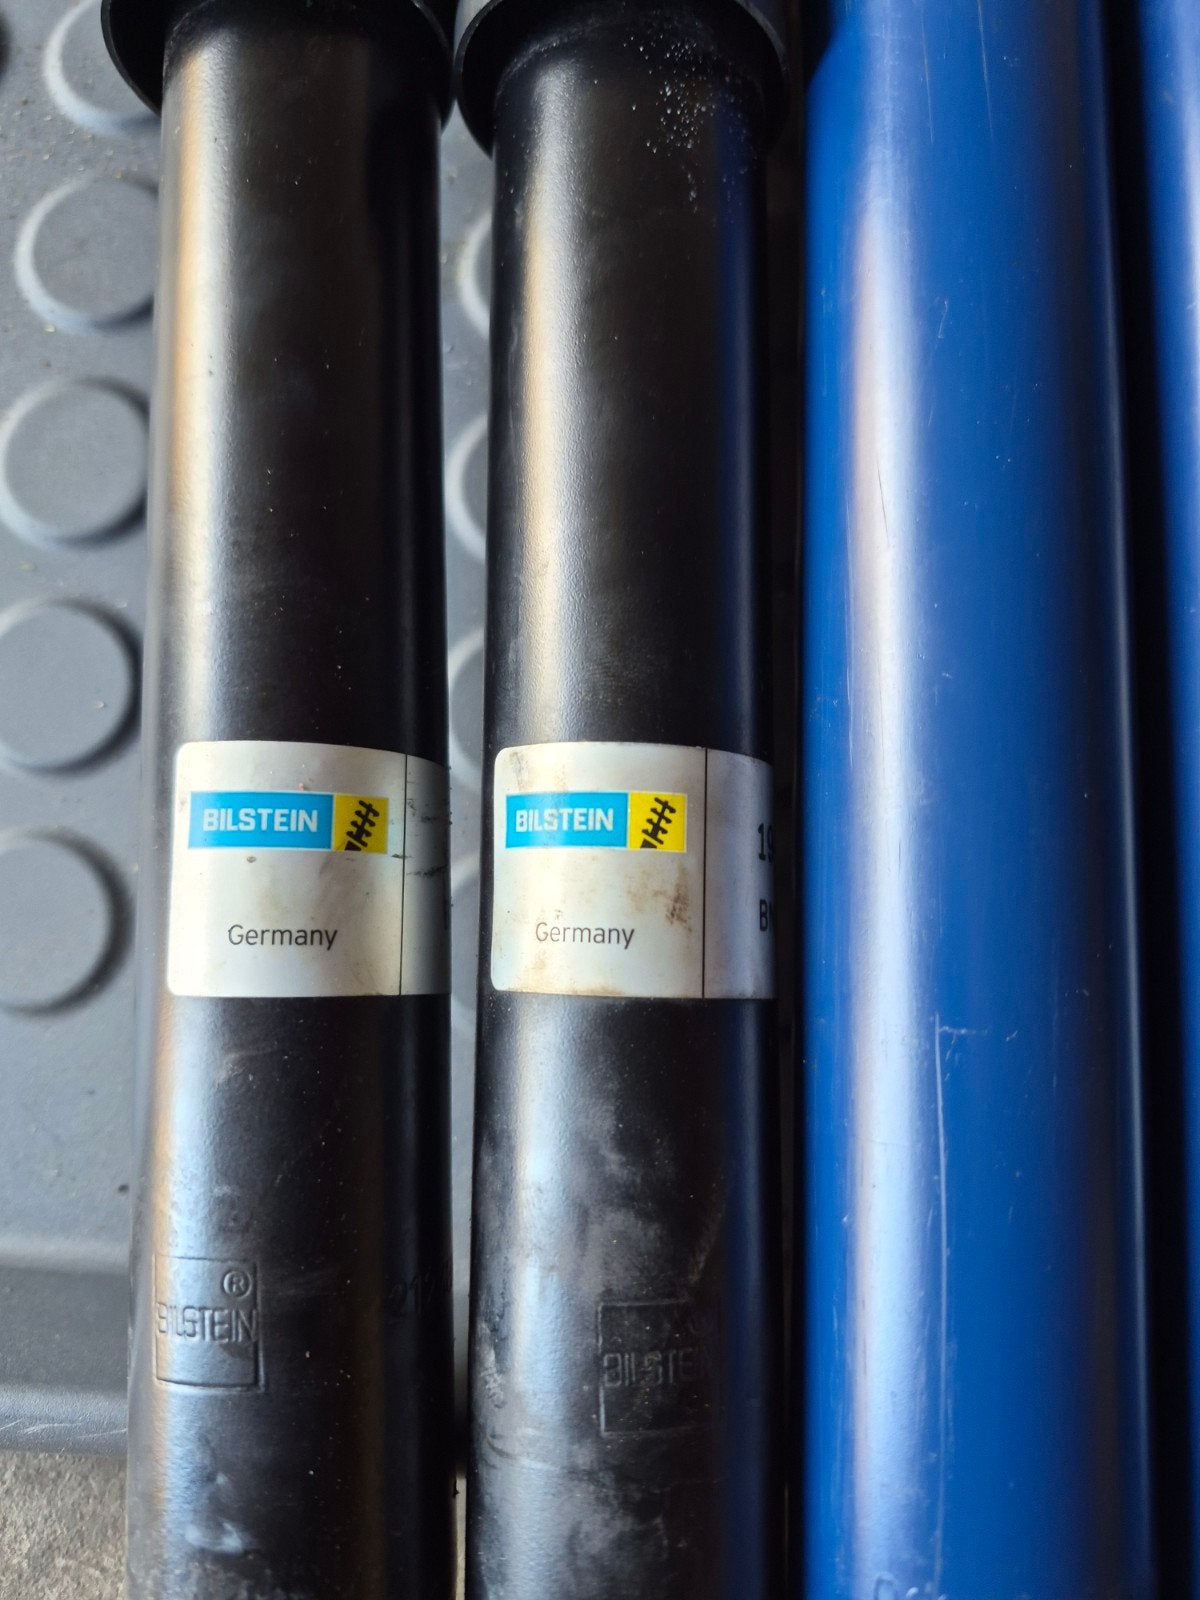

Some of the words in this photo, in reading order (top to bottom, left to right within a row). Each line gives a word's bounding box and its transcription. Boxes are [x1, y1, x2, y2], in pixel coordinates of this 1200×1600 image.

[202, 808, 318, 833] BILSTEIN
[515, 807, 614, 832] BILSTEIN
[227, 924, 338, 951] Germany
[535, 921, 635, 950] Germany
[155, 1301, 259, 1344] BILSTEIN
